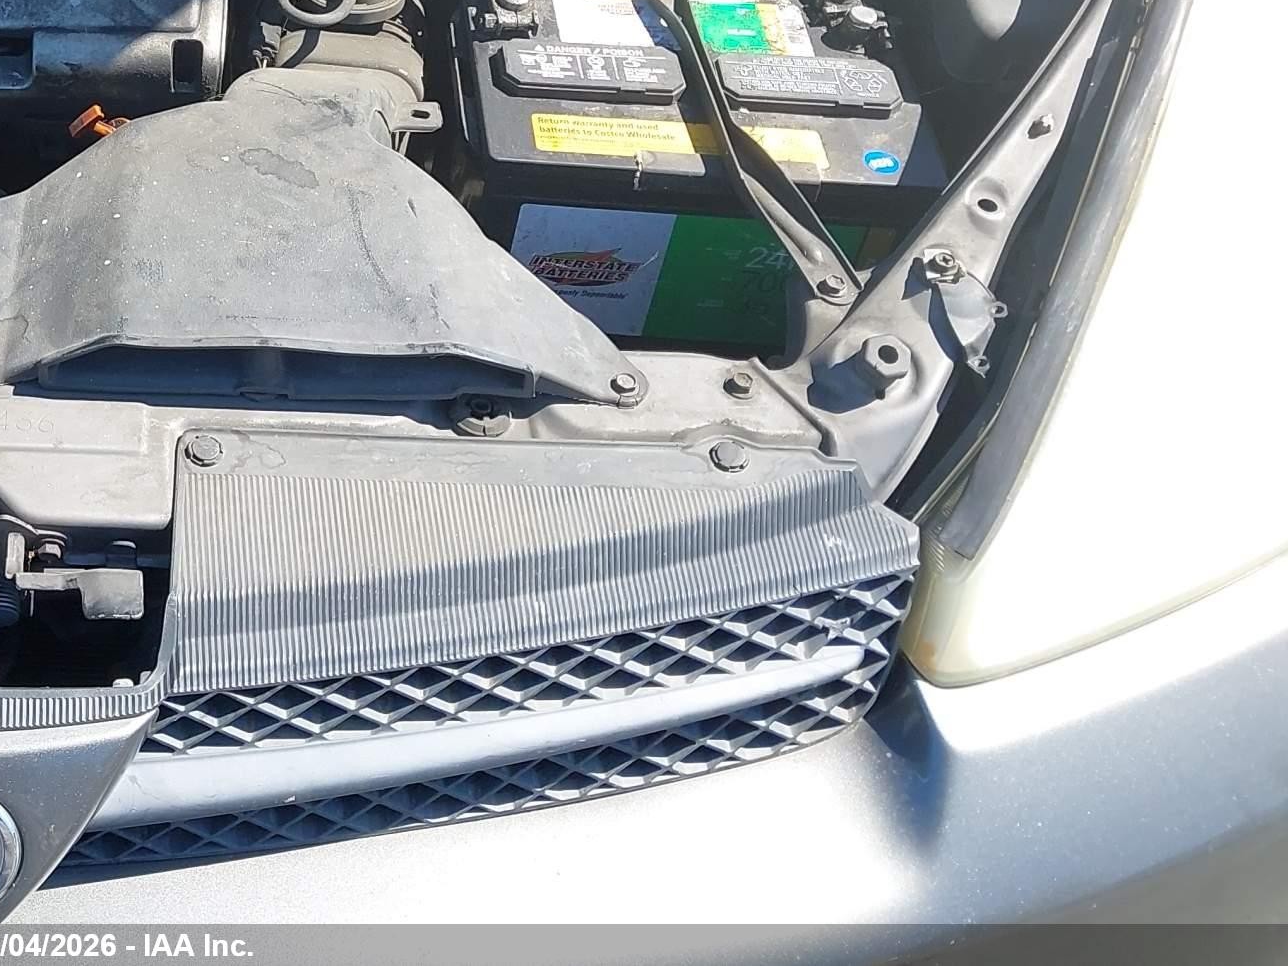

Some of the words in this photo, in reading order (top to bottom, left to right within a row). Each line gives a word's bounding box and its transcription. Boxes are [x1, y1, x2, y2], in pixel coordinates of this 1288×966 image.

[546, 45, 592, 55] DANGER
[603, 47, 644, 57] POISON
[537, 116, 570, 125] Return
[572, 120, 614, 130] warranty
[616, 122, 634, 130] and
[539, 126, 581, 136] batteries
[594, 130, 626, 138] Costco
[627, 131, 676, 141] Wholesale
[530, 254, 640, 272] INTERSTATE
[744, 246, 793, 270] 24
[532, 266, 630, 281] BATTERIES
